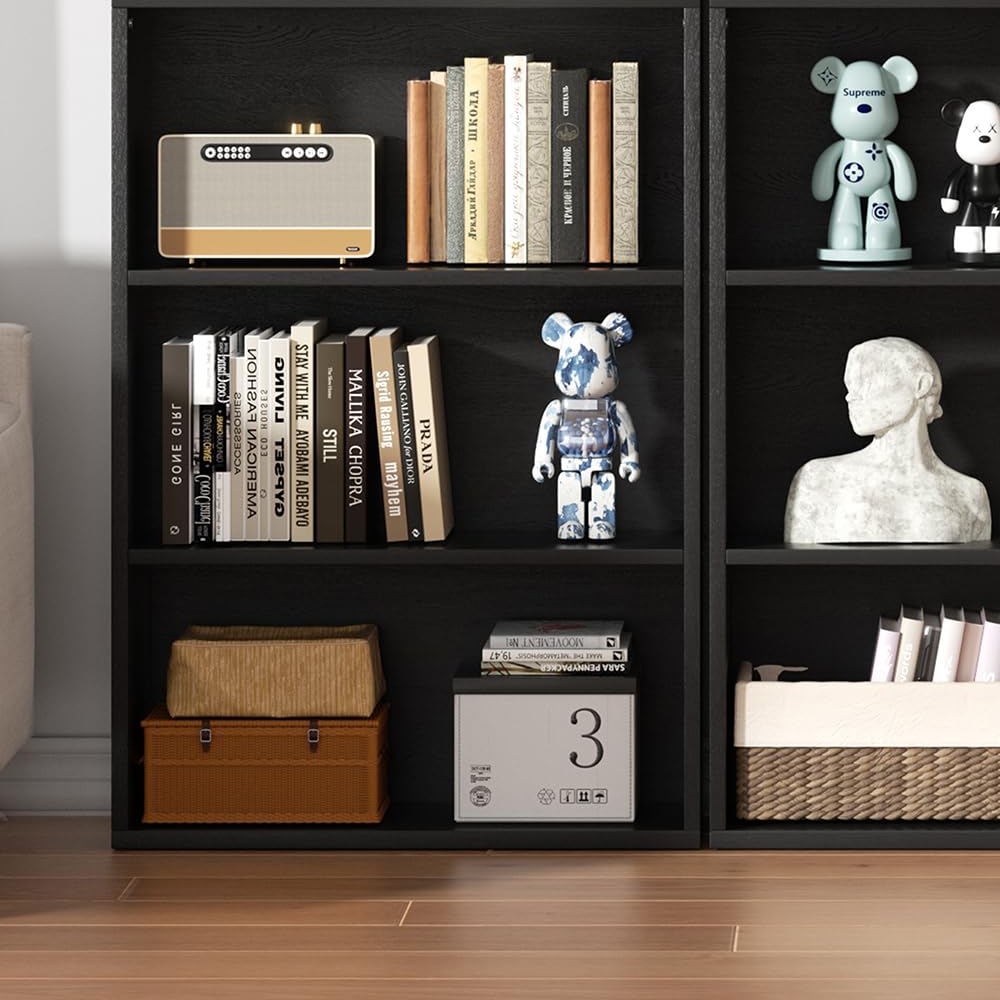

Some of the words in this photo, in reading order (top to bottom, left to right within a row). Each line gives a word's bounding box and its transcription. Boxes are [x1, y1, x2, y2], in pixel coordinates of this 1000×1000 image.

[842, 87, 886, 98] Supreme
[562, 146, 573, 179] ЧЕРНОЕ
[563, 189, 573, 225] КРАСНОЕ
[295, 344, 309, 372] STAY
[295, 373, 309, 401] WITH
[375, 370, 392, 402] Sigrid
[396, 363, 408, 391] JOHN
[295, 404, 309, 420] ME
[348, 368, 363, 437] MALLIKA
[399, 393, 412, 445] GALLIANO
[378, 405, 395, 449] Rausing
[295, 429, 309, 477] AYOBAMI
[322, 428, 338, 463] STILL
[403, 445, 415, 458] for
[419, 418, 434, 474] PRADA
[348, 445, 363, 507] CHOPRA
[405, 458, 416, 485] DIOR
[295, 479, 309, 528] ADEBAYO
[381, 462, 403, 517] mayhem
[540, 663, 601, 673] PENNYPACKER
[600, 663, 626, 672] SARA
[569, 707, 604, 769] 3
